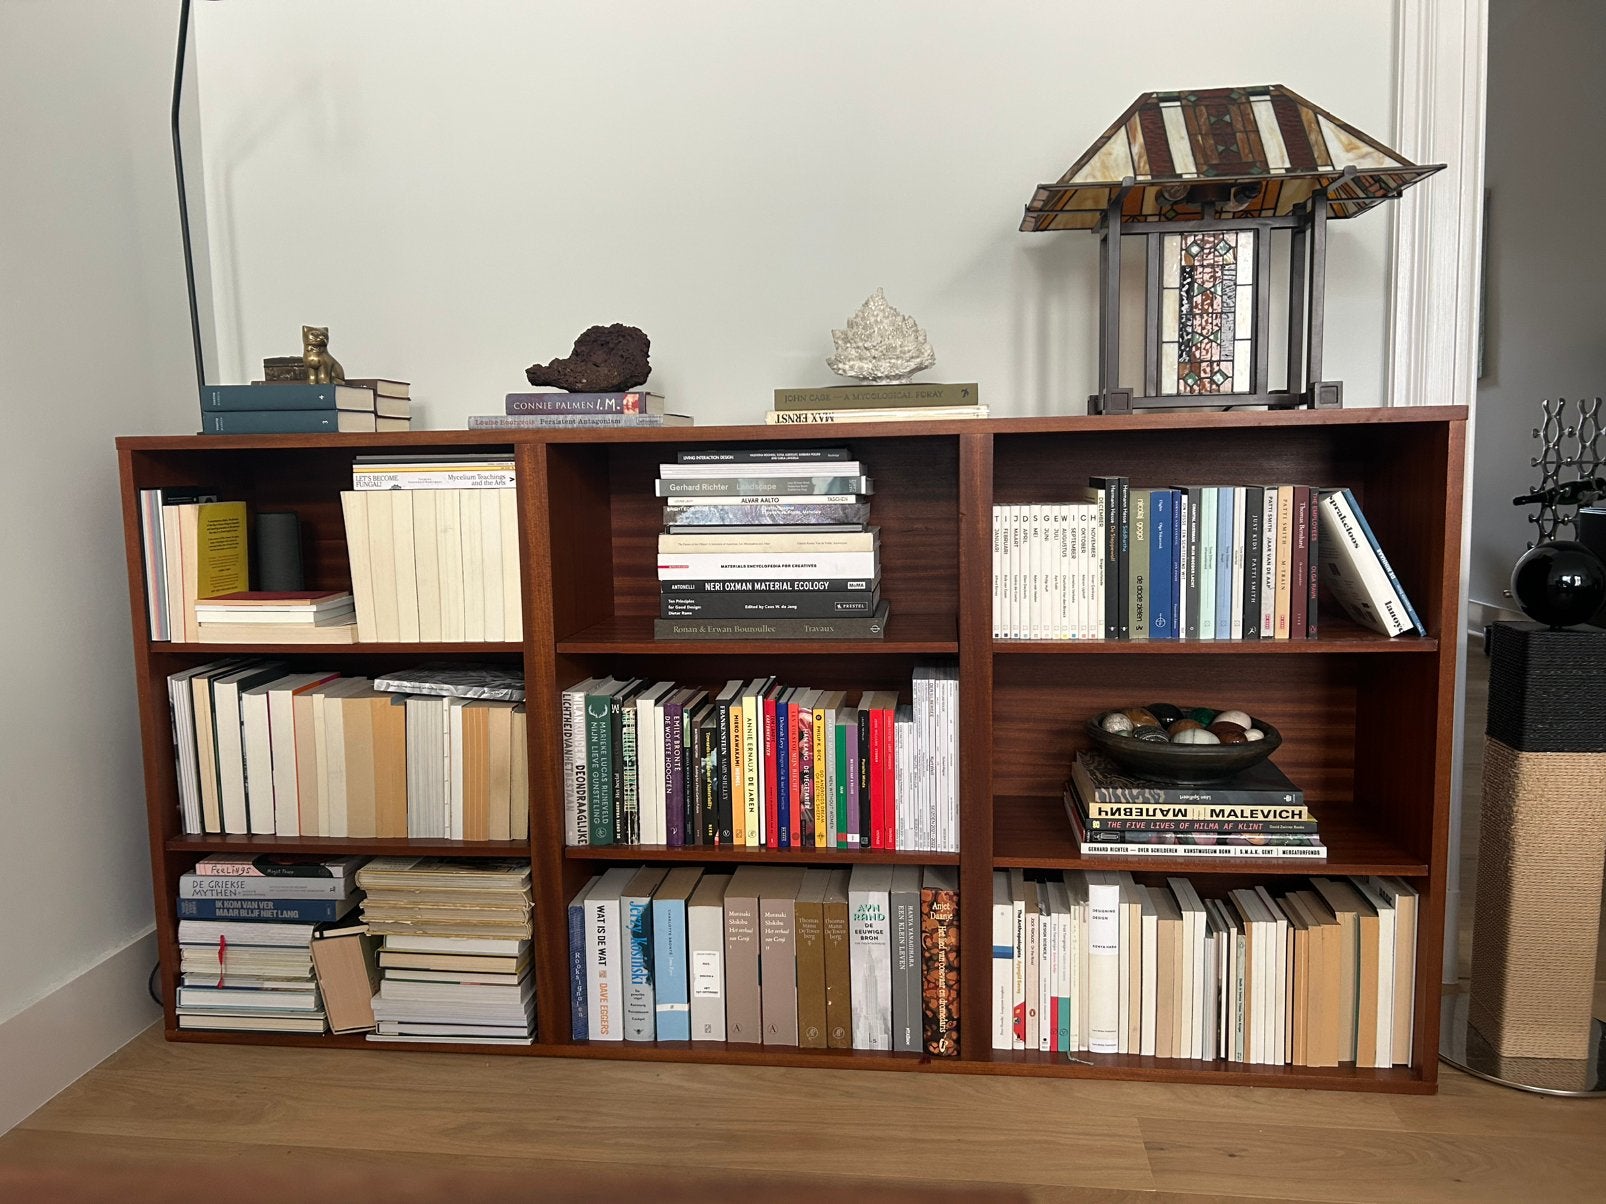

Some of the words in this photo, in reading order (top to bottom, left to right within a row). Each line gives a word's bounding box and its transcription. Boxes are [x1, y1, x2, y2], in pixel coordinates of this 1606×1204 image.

[785, 394, 806, 403] JOHN
[809, 393, 831, 401] CAGE
[844, 393, 851, 401] A
[852, 391, 913, 401] MYCOLOGICAL
[915, 390, 943, 399] FORAY
[556, 401, 594, 409] PALMEN
[597, 398, 621, 411] I.M.
[775, 413, 808, 423] ERNST
[811, 413, 835, 422] MAX
[737, 483, 776, 491] Landscape
[1266, 567, 1271, 575] DE
[705, 582, 722, 591] NERI
[724, 582, 752, 590] OXMAN
[754, 582, 792, 590] MATERIAL
[794, 581, 829, 590] ECOLOGY
[673, 625, 697, 633] Ronan
[699, 625, 706, 633] &
[707, 625, 732, 633] Erwan
[734, 624, 776, 633] Bouroullec
[805, 624, 834, 632] Travaux
[665, 716, 671, 724] DE
[748, 777, 754, 787] DE
[592, 772, 600, 824] GUNSTELING
[601, 785, 609, 824] RIJNEVELD
[1098, 807, 1188, 817] МАЛЕВИЧ
[1210, 808, 1303, 819] MALEVICH
[1150, 821, 1175, 829] LIVES
[1194, 822, 1219, 830] HILMA
[215, 900, 222, 908] IK
[223, 900, 240, 908] KOM
[242, 901, 258, 909] VAN
[259, 901, 273, 909] VER
[858, 904, 881, 913] AYN
[932, 902, 951, 911] Anjet
[216, 909, 239, 917] MAAR
[261, 910, 277, 918] NIET
[278, 910, 299, 918] LANG
[597, 905, 605, 923] WAT
[626, 901, 646, 933] Jerzy
[853, 913, 885, 921] RAND
[930, 912, 953, 920] Daanje
[938, 926, 946, 936] Het
[598, 936, 606, 946] DE
[938, 938, 946, 949] lied
[598, 948, 606, 966] WAT
[631, 937, 651, 984] Kosinski
[938, 951, 946, 961] van
[938, 962, 946, 988] ooievaar
[599, 983, 608, 1003] DAVE
[600, 1005, 608, 1035] EGGERS
[939, 999, 948, 1032] dromedaris
